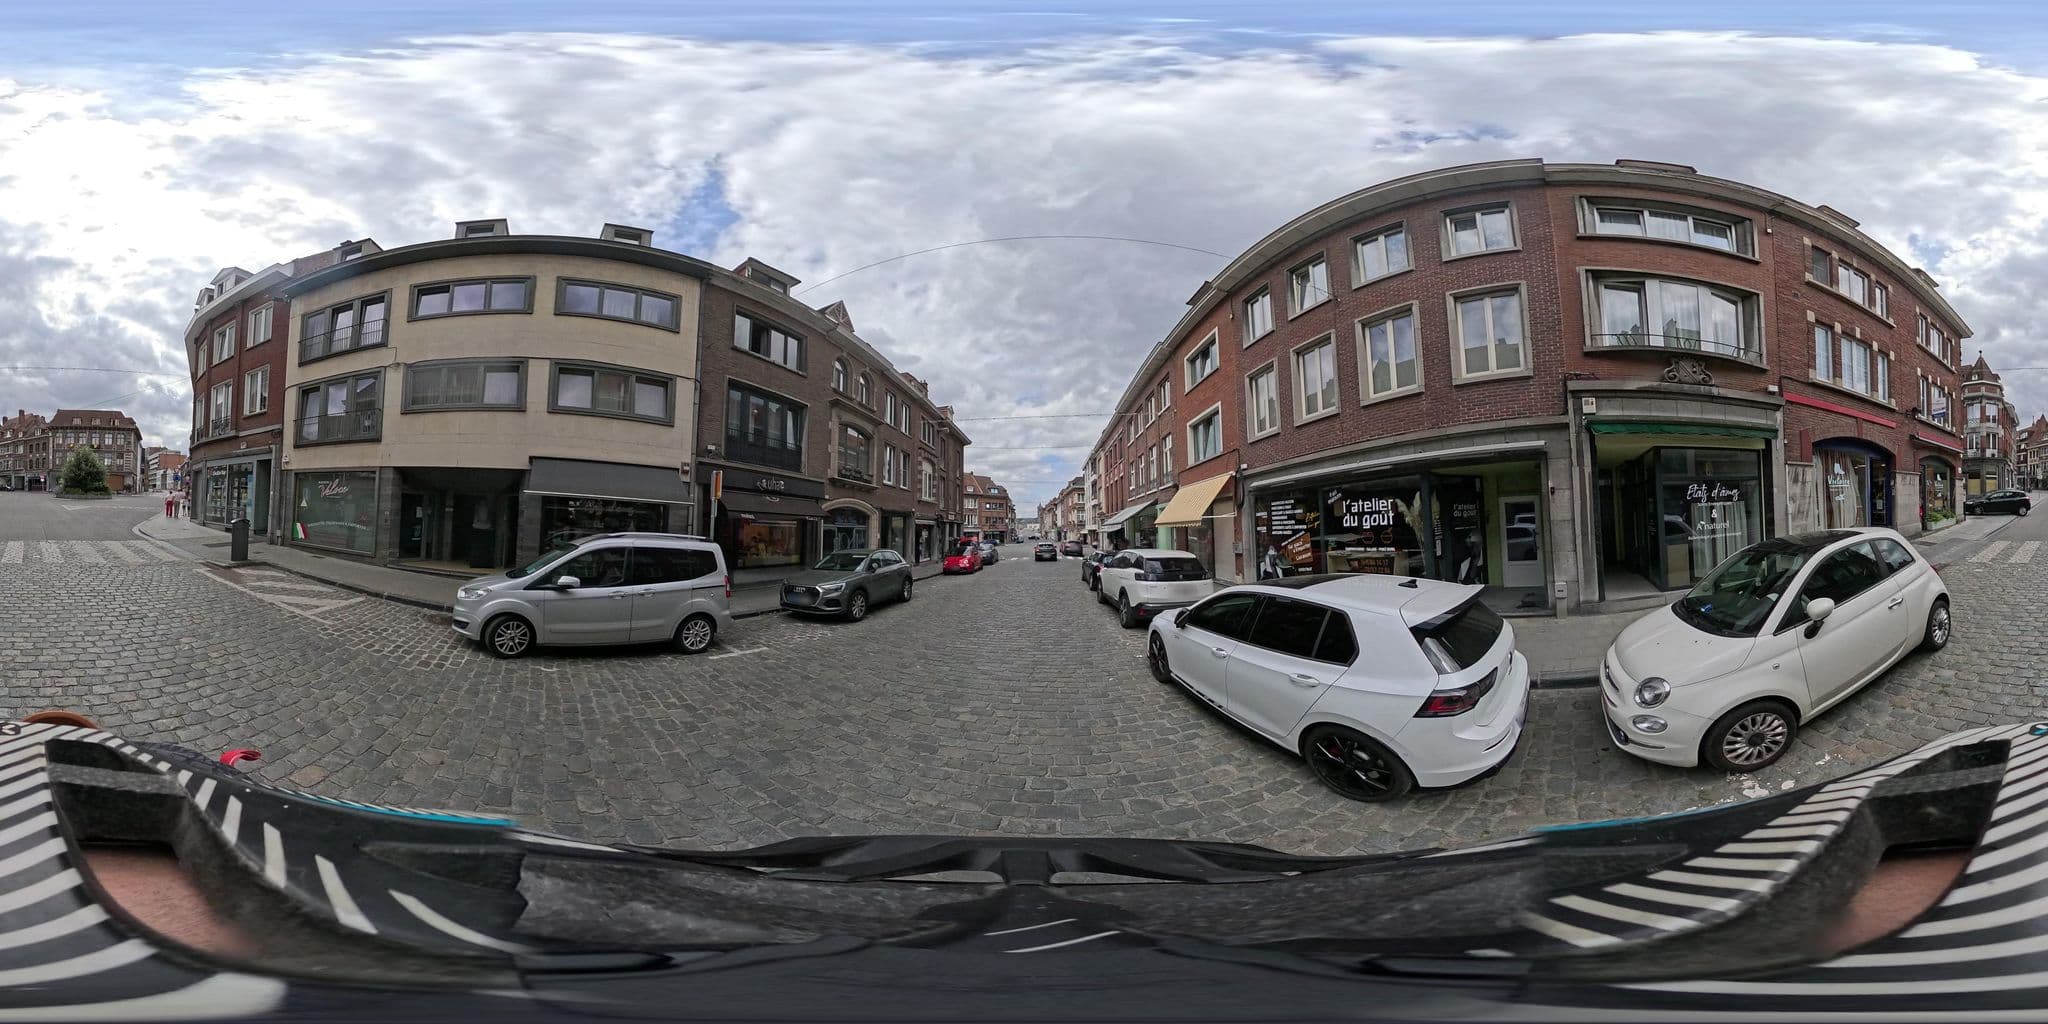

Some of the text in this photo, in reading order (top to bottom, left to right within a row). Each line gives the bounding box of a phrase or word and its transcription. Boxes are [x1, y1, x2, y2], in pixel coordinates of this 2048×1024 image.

[1342, 498, 1394, 513] l'atelier
[1711, 508, 1718, 518] &
[1343, 510, 1395, 529] du goût
